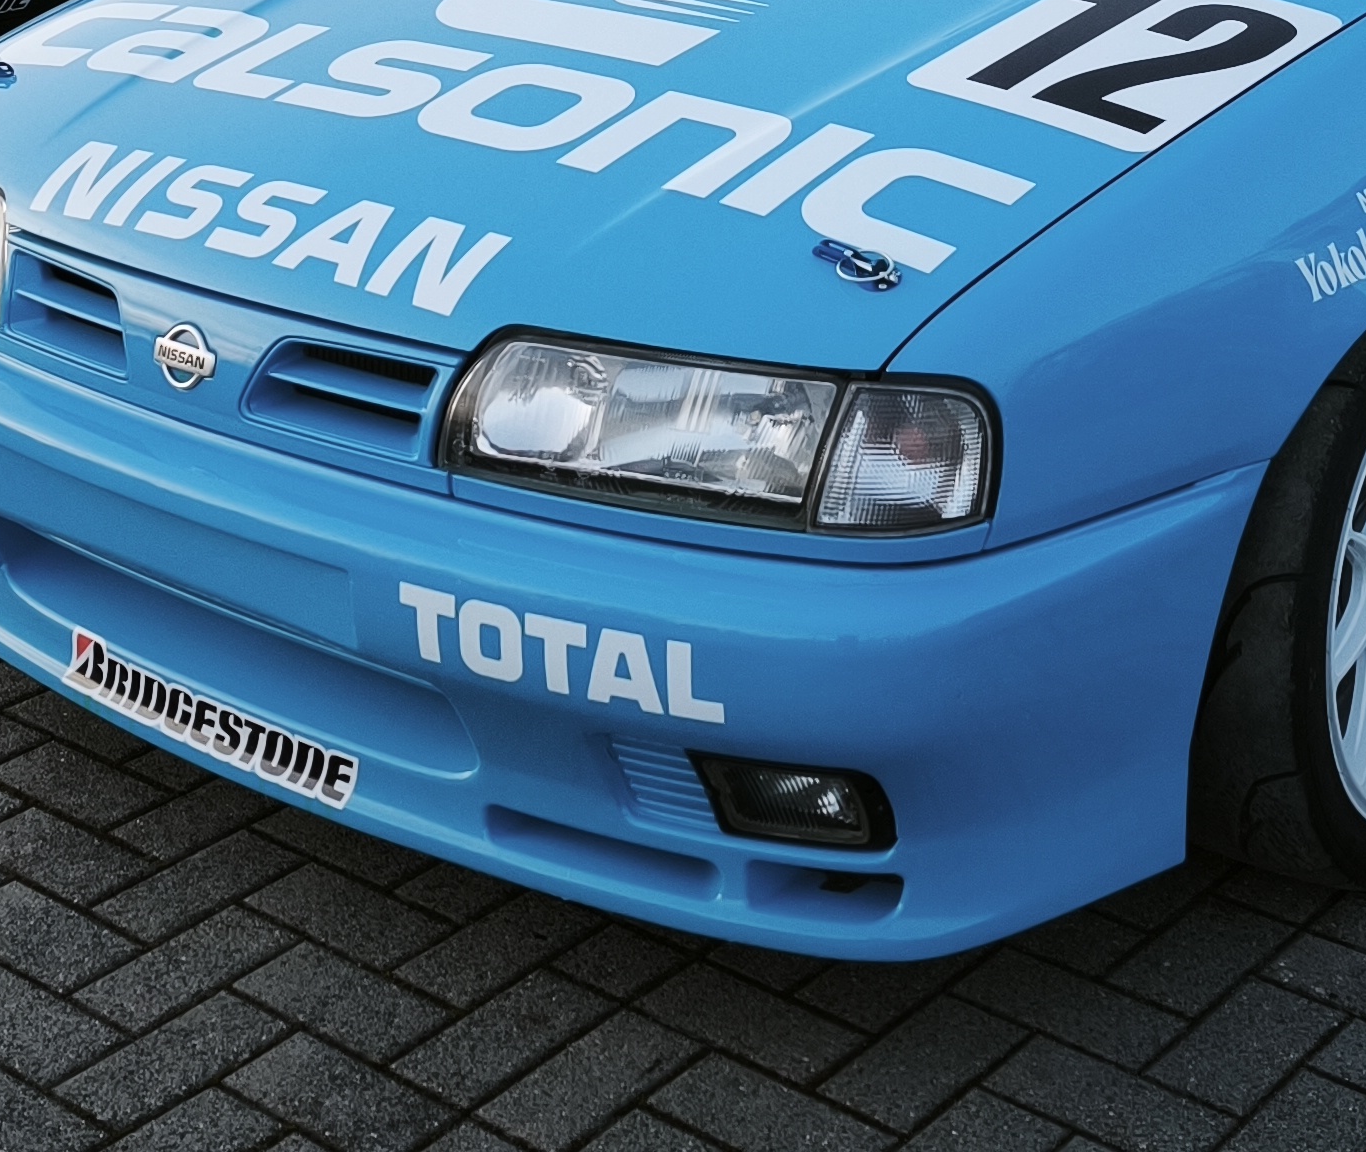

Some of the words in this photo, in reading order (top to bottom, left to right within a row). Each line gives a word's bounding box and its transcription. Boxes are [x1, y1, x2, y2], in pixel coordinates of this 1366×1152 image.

[31, 139, 512, 317] NISSAN
[157, 344, 206, 371] NISSAN
[65, 627, 358, 810] BRIDGESTONE
[398, 580, 726, 726] TOTAL
